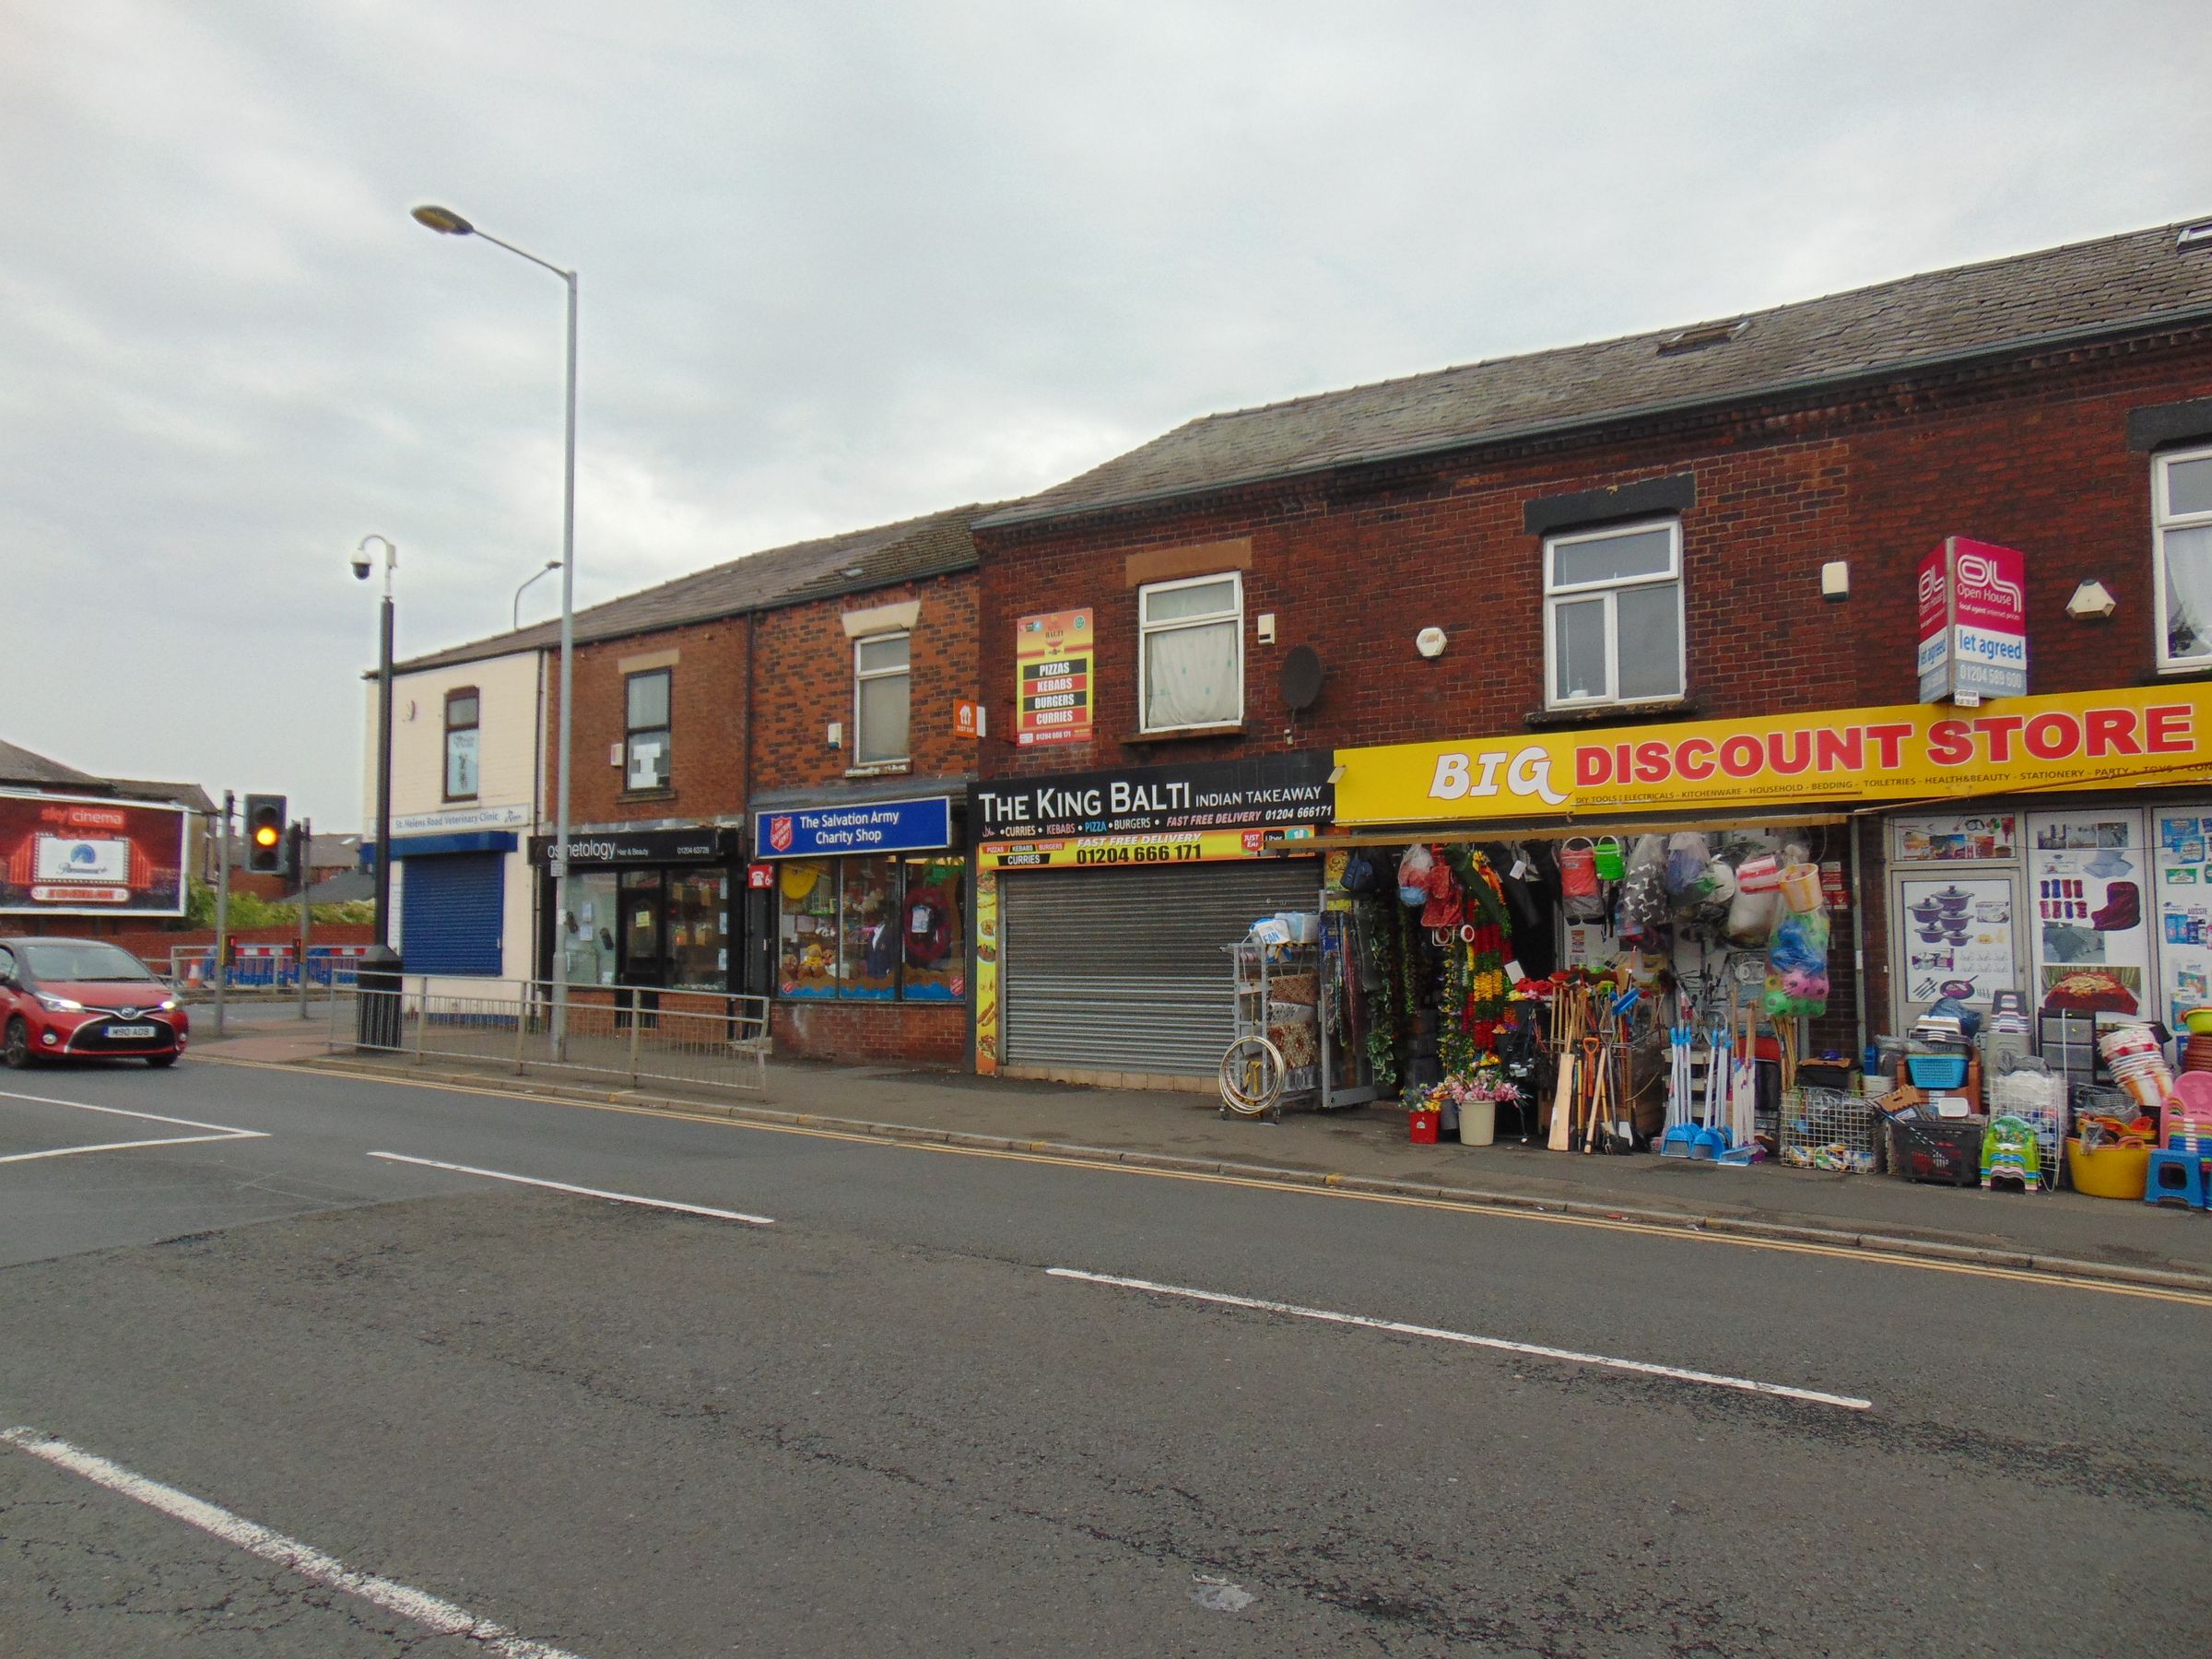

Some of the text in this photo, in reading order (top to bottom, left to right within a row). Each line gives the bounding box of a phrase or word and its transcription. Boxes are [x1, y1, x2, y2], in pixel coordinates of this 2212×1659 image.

[1957, 583, 2012, 606] Open House
[1959, 629, 2022, 660] let agreed
[1039, 662, 1070, 677] PIZZAS
[1037, 677, 1073, 693] KEBABS
[1034, 693, 1075, 710] BURGERS
[1036, 710, 1074, 725] CURRIES
[1428, 703, 2195, 806] BIG DISCOUNT STORE
[1575, 796, 1589, 805] DIY
[1624, 792, 1675, 802] ELECTRICALS
[1681, 787, 1742, 798] KITCHENWARE
[1749, 784, 1804, 794] HOUSEHOLD
[1811, 781, 1853, 791] BEDDING
[1864, 777, 1916, 787] TOILETRIES
[1924, 773, 2010, 784] HEALTH&BEAUTY
[2019, 770, 2085, 781] STATIONERY
[2094, 767, 2130, 777] PARTY
[978, 782, 1323, 823] THE KING BALTI INDIAN TAKEAWAY
[72, 810, 123, 825] cinema
[426, 817, 443, 826] Road
[444, 814, 478, 825] Veterinary
[479, 811, 499, 822] Clinic
[799, 810, 900, 829] The Salvation Army
[1005, 805, 1332, 837] CURRIES KEBABS PIZZA BURGERS FAST FREE DELIVERY 01204 666171
[815, 828, 882, 846] Charity Shop
[1077, 832, 1202, 848] FAST FREE DELIVERY
[1243, 833, 1260, 842] JUST
[1011, 844, 1034, 853] KEBABS
[1076, 844, 1202, 865] 01204 666 171
[1007, 853, 1041, 865] CURRIES
